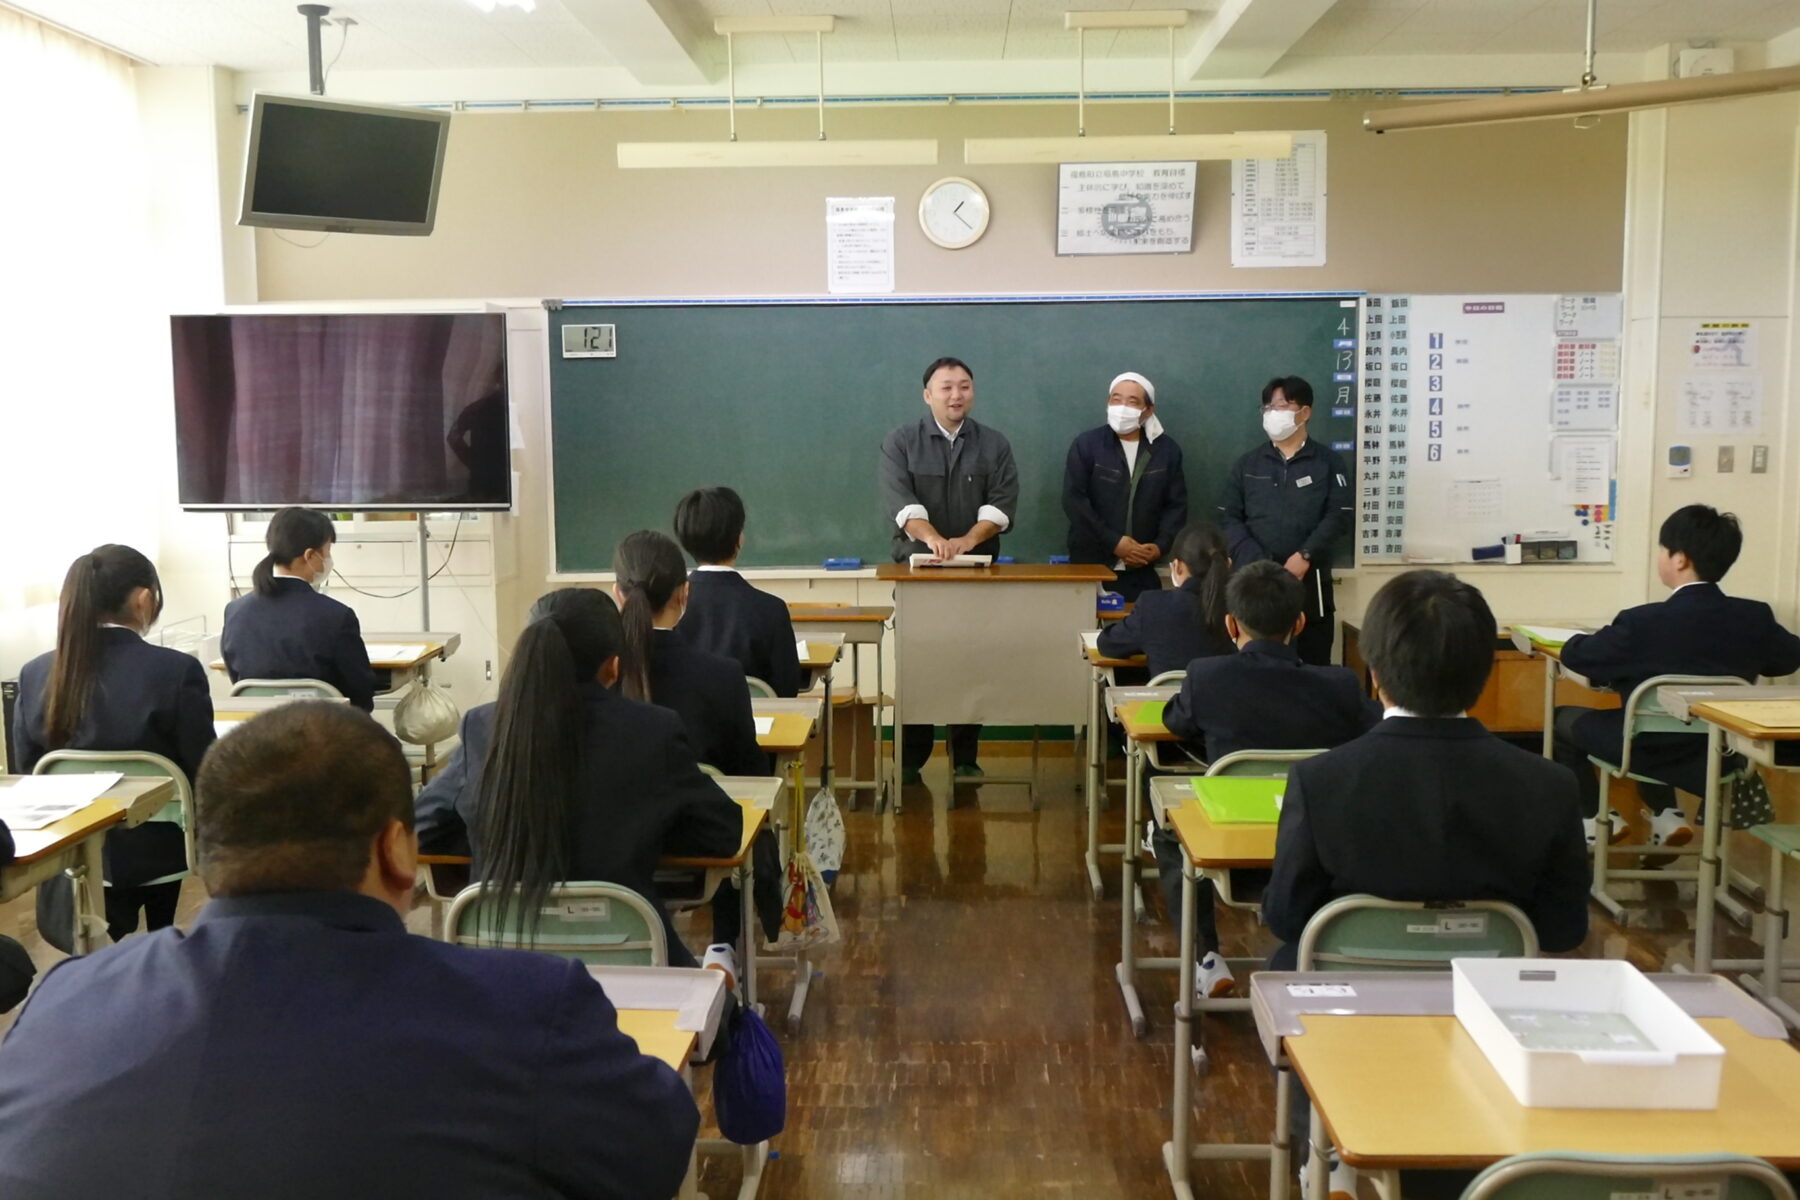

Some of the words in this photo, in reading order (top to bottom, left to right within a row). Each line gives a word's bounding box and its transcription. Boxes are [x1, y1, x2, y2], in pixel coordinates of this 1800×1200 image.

[1337, 317, 1350, 336] 4
[1366, 314, 1382, 324] 上田
[1389, 315, 1406, 324] 上田
[1433, 333, 1440, 349] 1
[1336, 350, 1353, 370] 13
[1365, 362, 1382, 371] 坂口
[1391, 363, 1407, 371] 坂口
[1431, 354, 1440, 369] 2
[1431, 376, 1440, 391] 3
[1335, 386, 1350, 404] 月
[1432, 398, 1441, 415] 4
[1431, 421, 1440, 437] 5
[1390, 456, 1406, 464] 平野
[1430, 444, 1439, 461] 6
[1364, 456, 1380, 465] 平野
[1363, 501, 1379, 510] 村田
[1388, 501, 1404, 509] 村田
